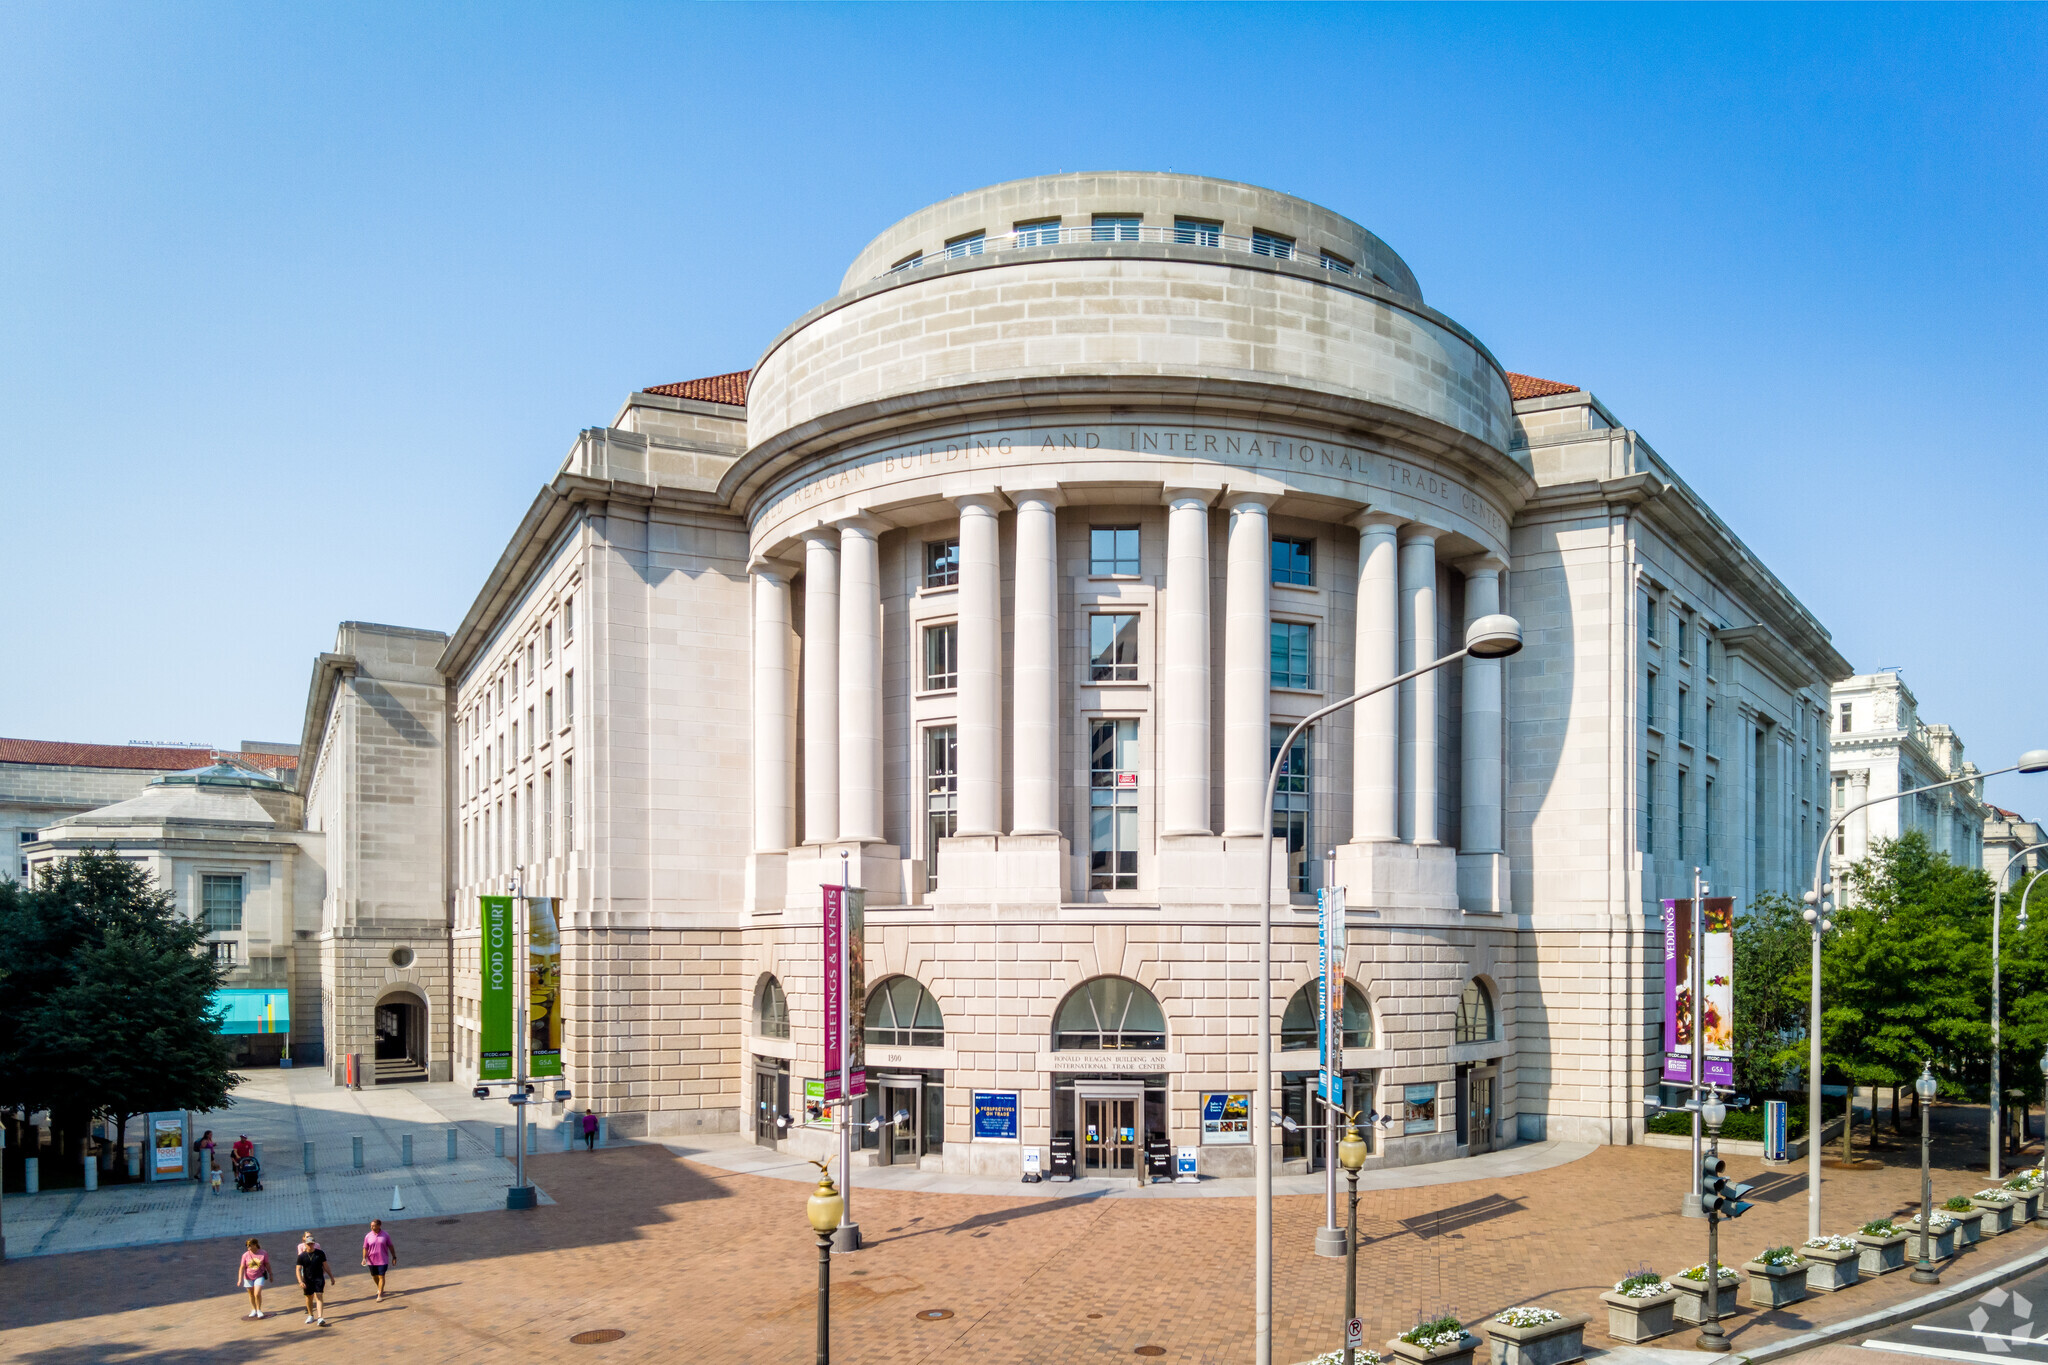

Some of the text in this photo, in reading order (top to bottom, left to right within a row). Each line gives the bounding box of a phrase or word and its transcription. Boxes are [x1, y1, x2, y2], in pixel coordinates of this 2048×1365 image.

[794, 462, 866, 505] REAGAN
[885, 437, 1013, 473] BUILDING
[1040, 431, 1101, 452] AND
[1129, 431, 1369, 474] INTERNATIONAL
[1388, 463, 1449, 499] TRADE
[1462, 492, 1503, 533] CENTER
[491, 903, 504, 990] FOOD COURT
[1666, 906, 1675, 960] WEDDINGS
[828, 890, 838, 1050] MEETINGS & EVENTS
[888, 1054, 902, 1063] 1300
[1115, 1055, 1147, 1063] BUILDING
[1150, 1055, 1167, 1063] AND
